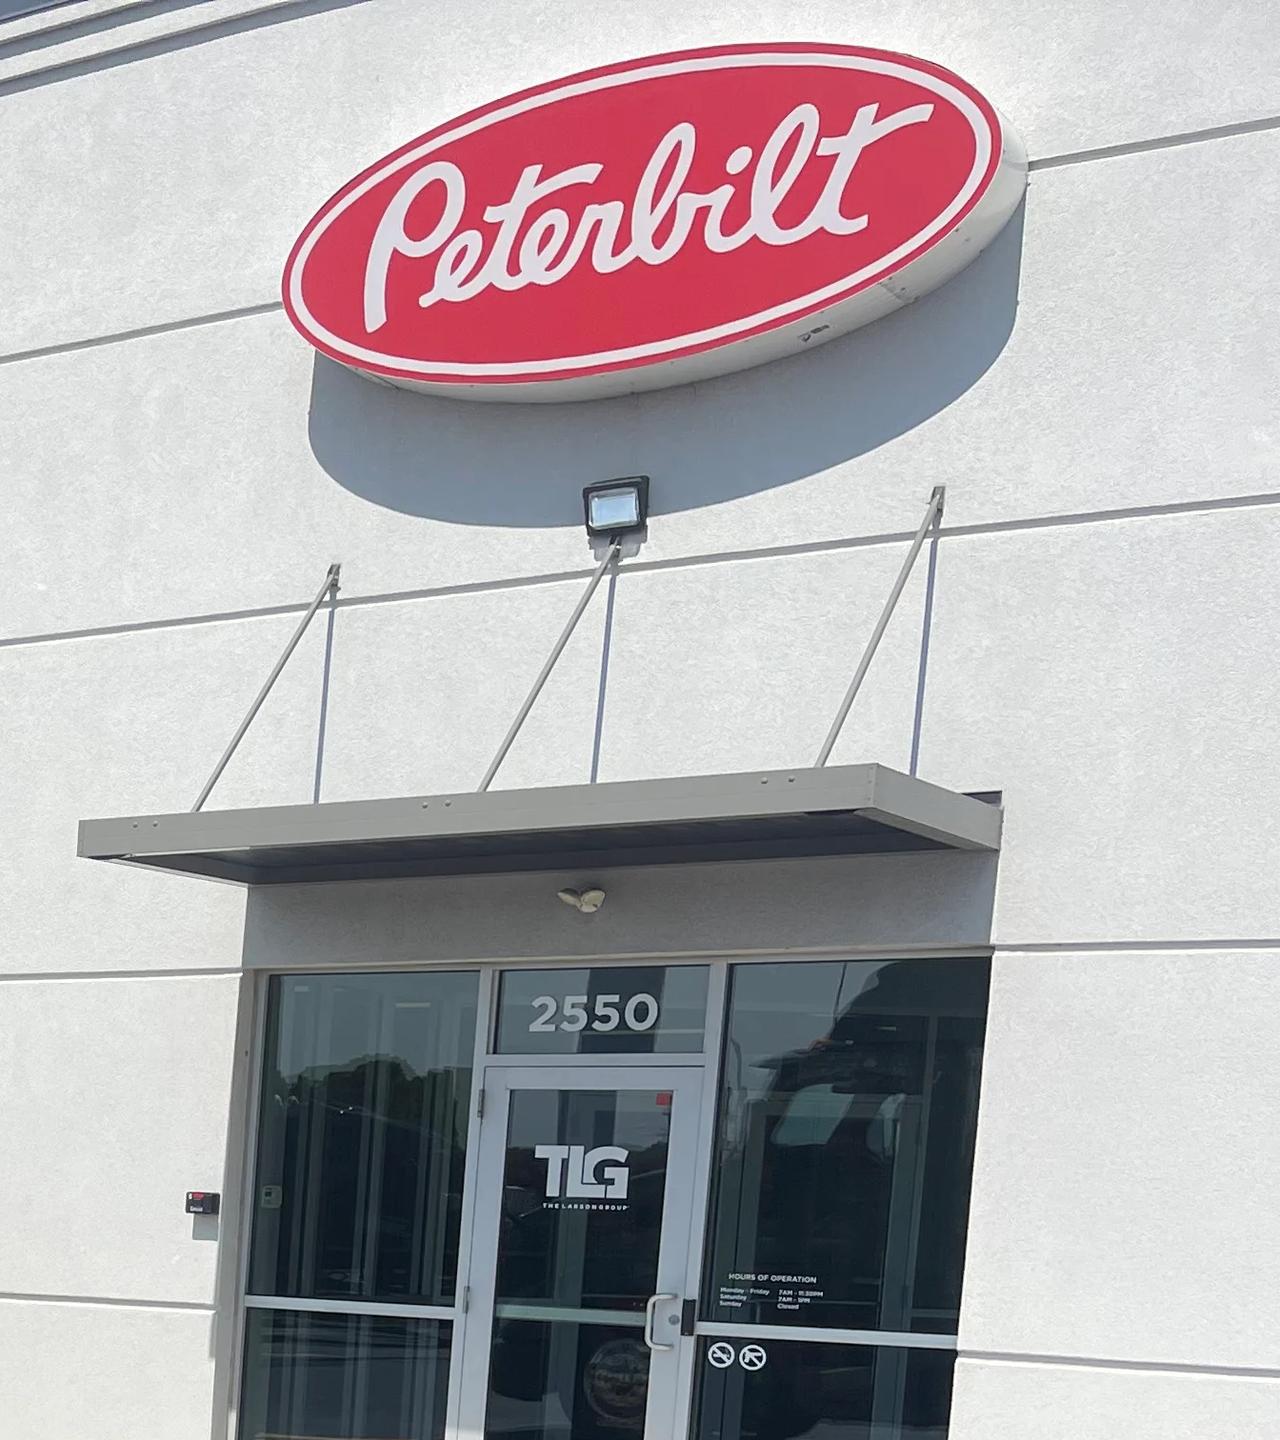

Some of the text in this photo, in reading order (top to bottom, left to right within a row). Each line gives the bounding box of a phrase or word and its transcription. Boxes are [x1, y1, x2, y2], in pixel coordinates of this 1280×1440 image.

[364, 102, 934, 333] Peterbilt
[528, 993, 659, 1032] 2550
[534, 1145, 630, 1199] TLG
[720, 1287, 745, 1295] Monday
[749, 1288, 770, 1296] Friday
[728, 1273, 756, 1281] HOURS
[770, 1274, 817, 1284] OPERATION
